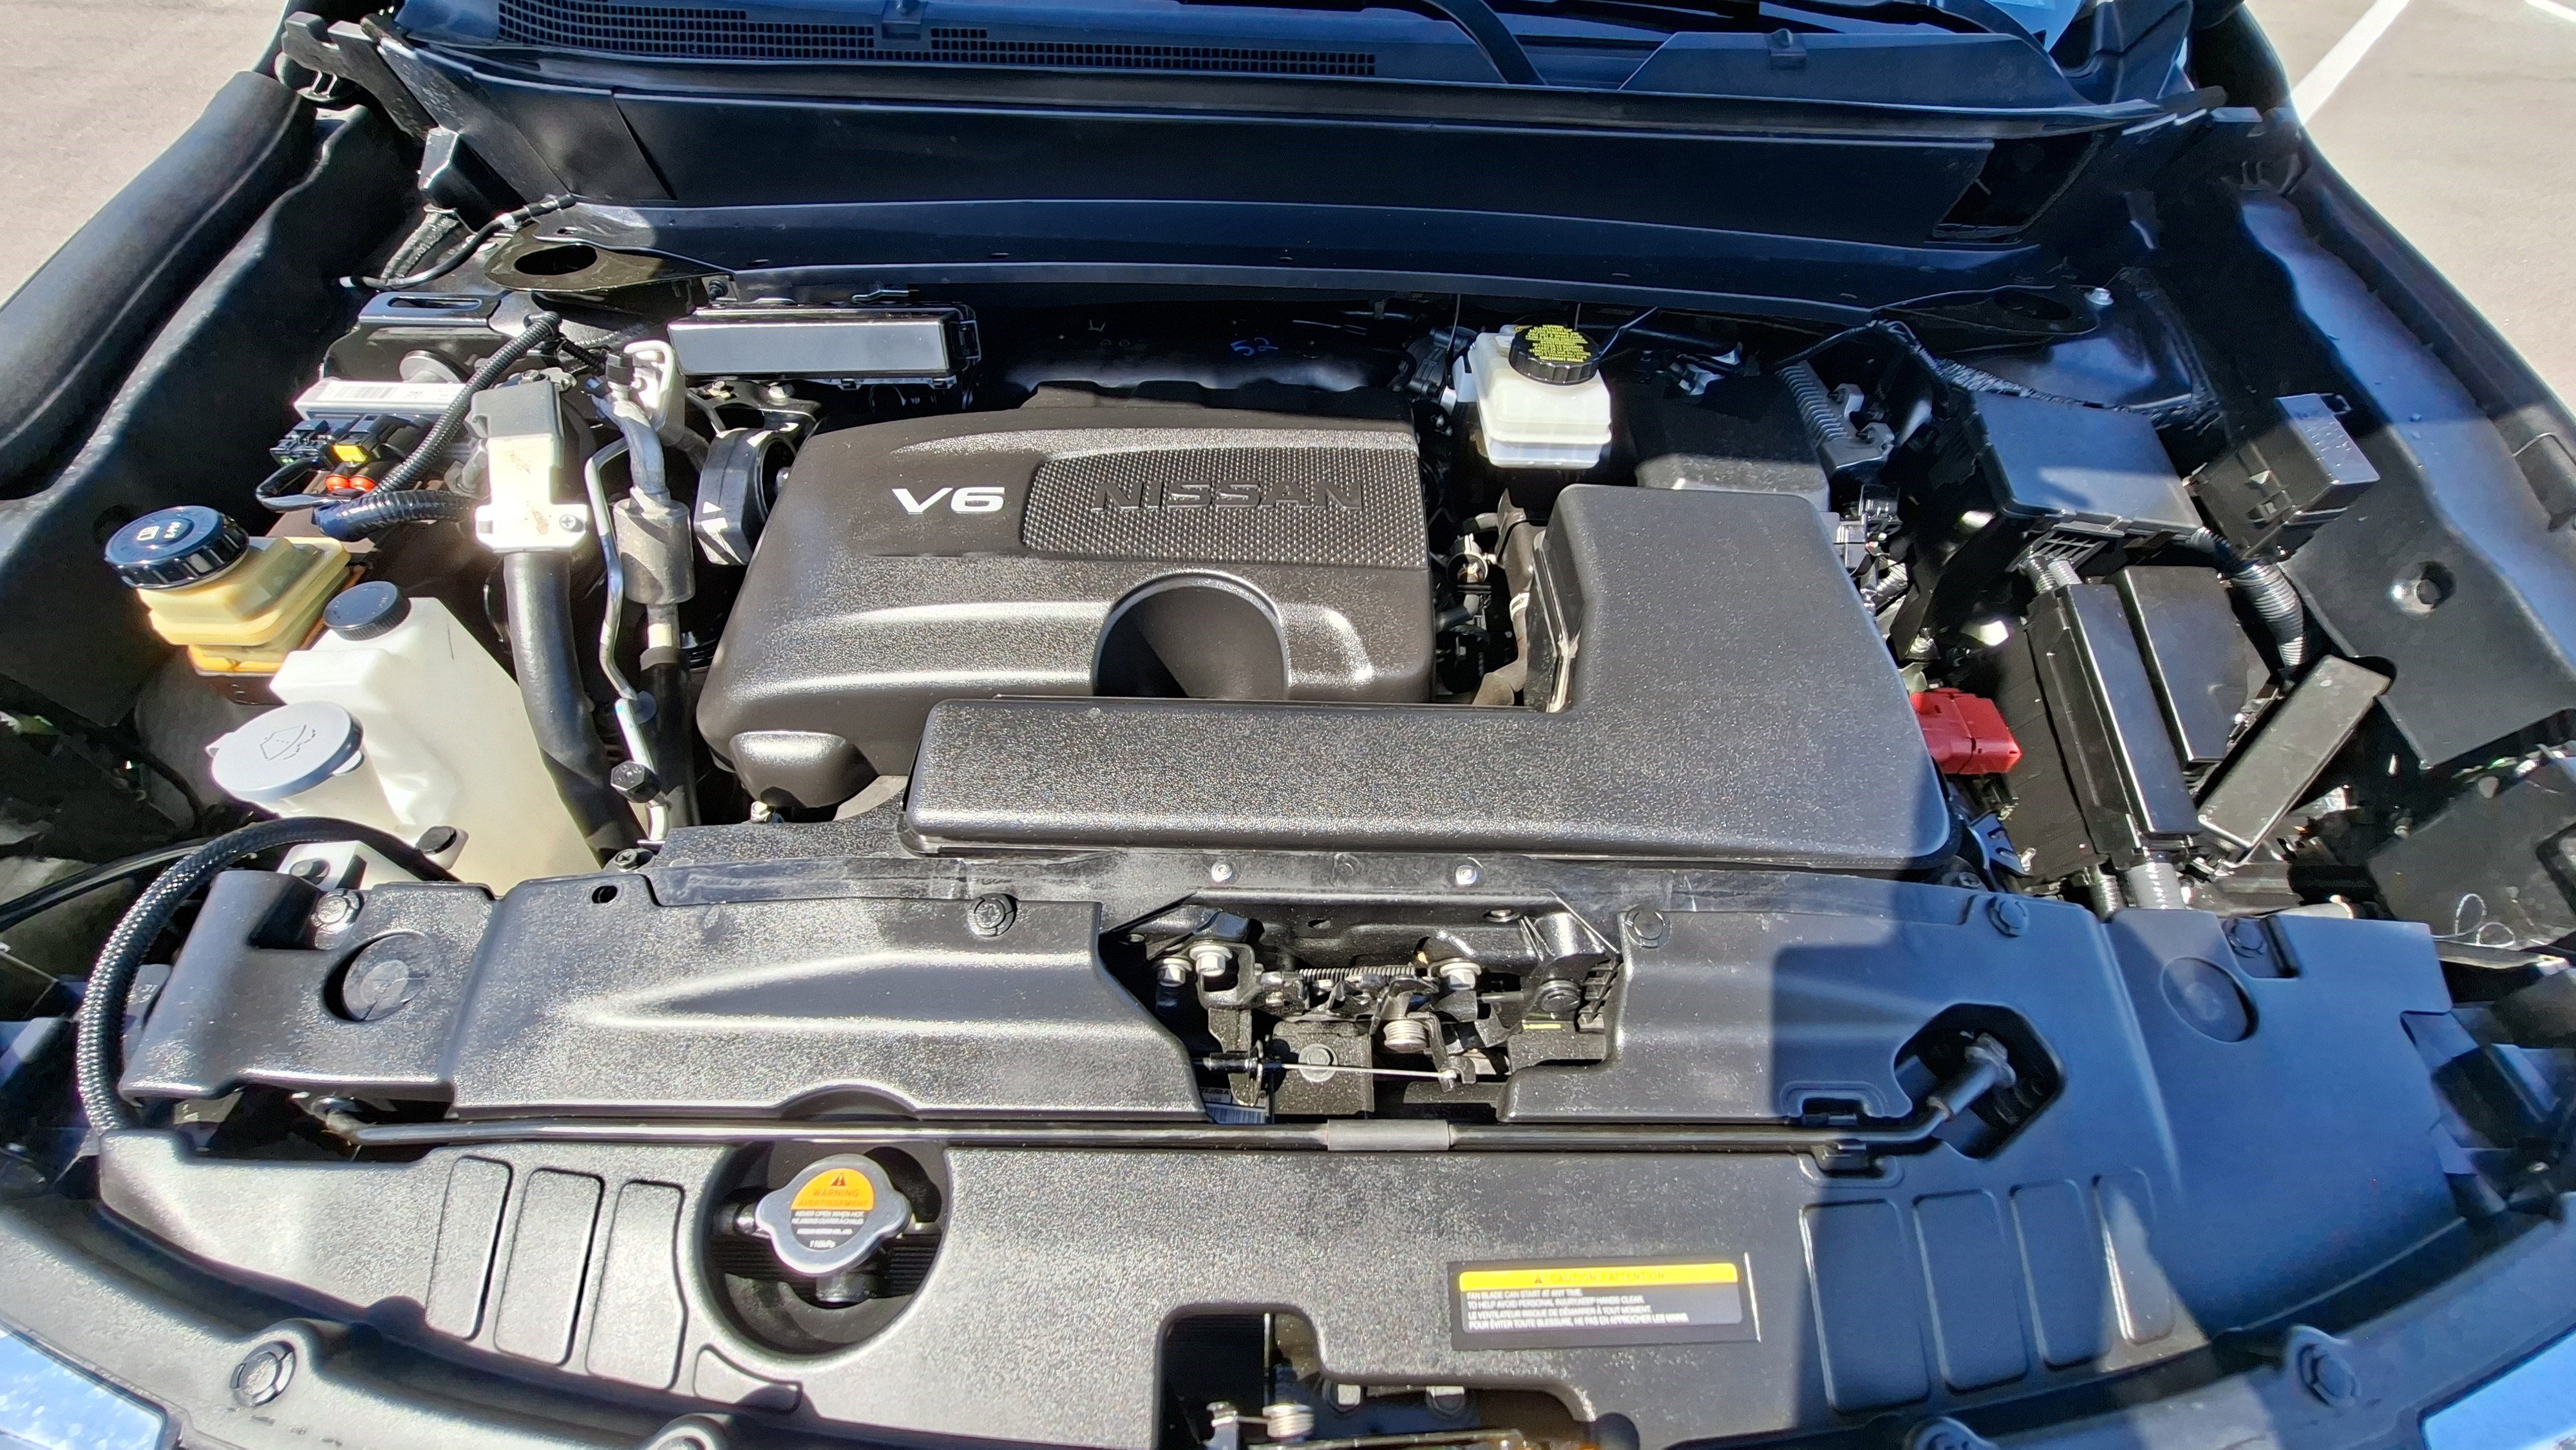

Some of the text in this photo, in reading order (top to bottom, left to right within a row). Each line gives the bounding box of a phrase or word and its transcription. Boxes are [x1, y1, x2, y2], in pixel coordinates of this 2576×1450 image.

[891, 487, 1006, 514] V6
[1092, 480, 1362, 511] NISSAN
[813, 1189, 859, 1197] WARNING
[1551, 1273, 1596, 1284] CAUTION
[1609, 1270, 1665, 1281] ATTENTION
[1504, 1290, 1519, 1299] CAN
[1467, 1301, 1477, 1310] TO
[1478, 1300, 1496, 1310] HELP
[1468, 1311, 1477, 1321] LE
[1468, 1321, 1490, 1330] POUR
